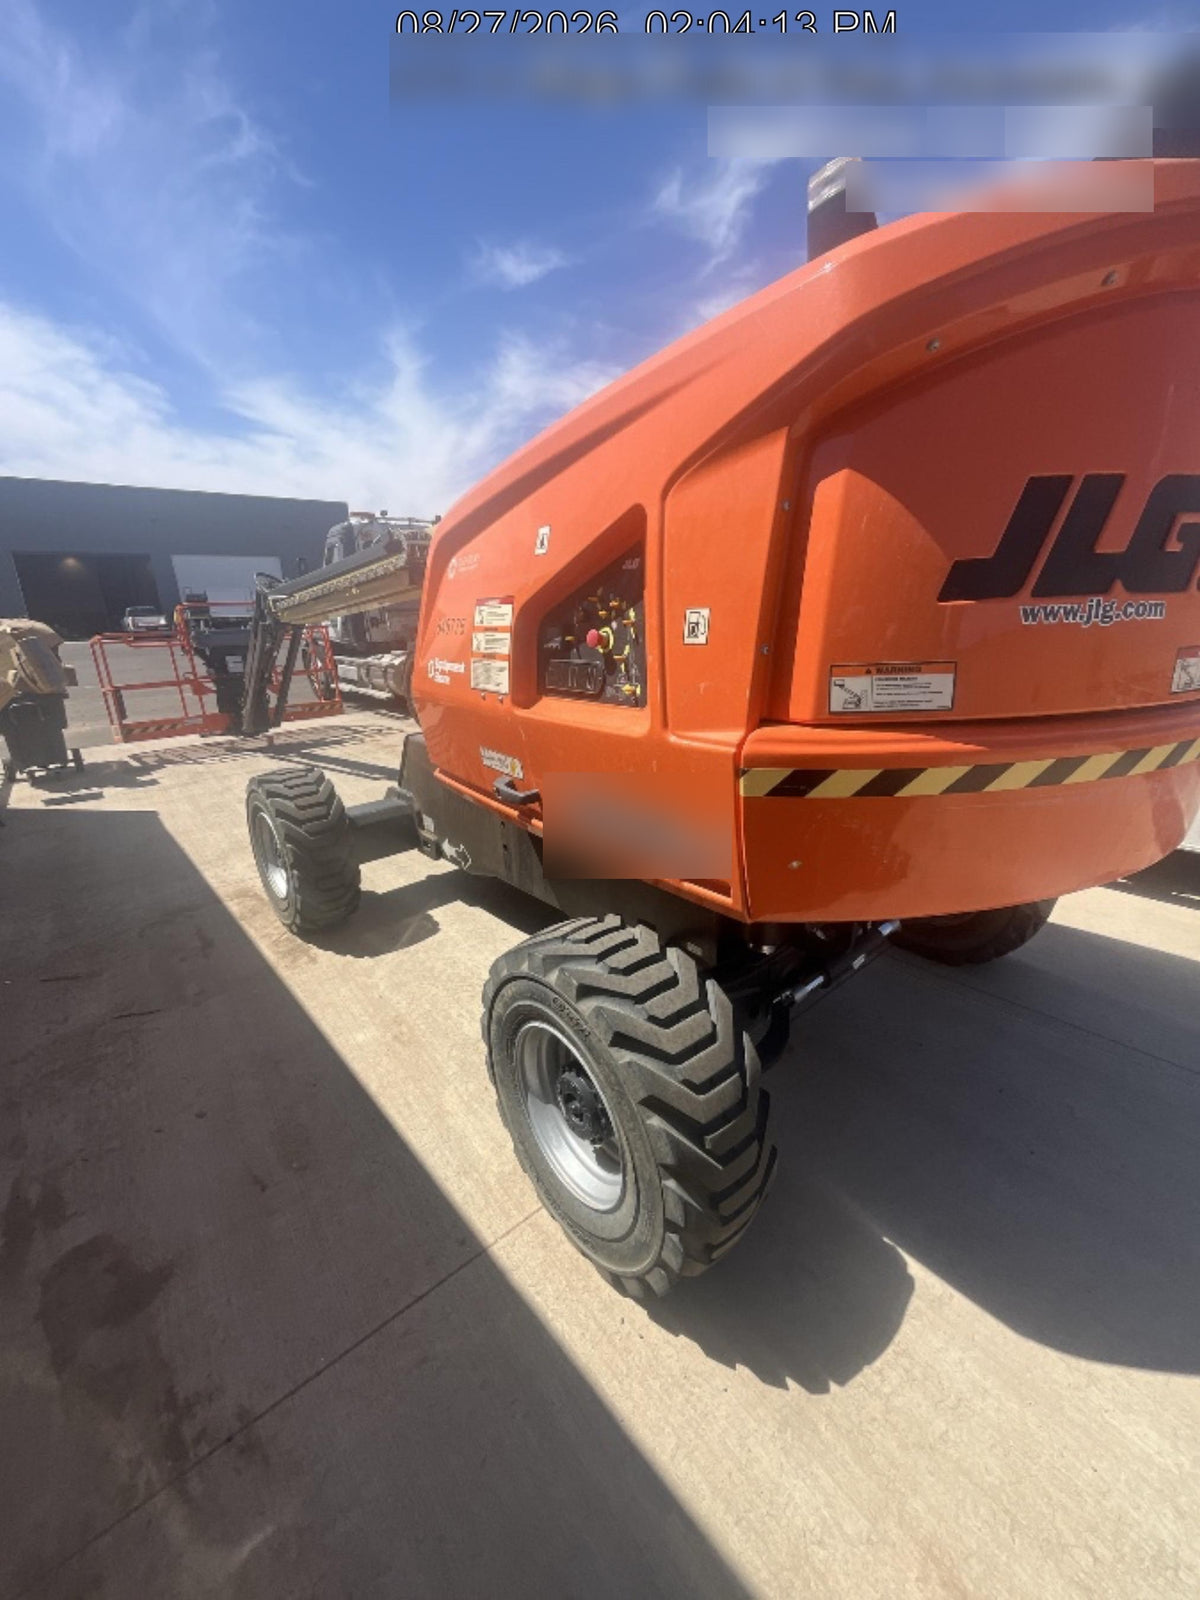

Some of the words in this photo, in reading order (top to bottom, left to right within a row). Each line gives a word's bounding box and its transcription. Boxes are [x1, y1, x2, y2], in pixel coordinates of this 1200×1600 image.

[937, 472, 1200, 602] JLG
[1020, 598, 1166, 628] www.jlg.com
[875, 666, 922, 675] WARNING
